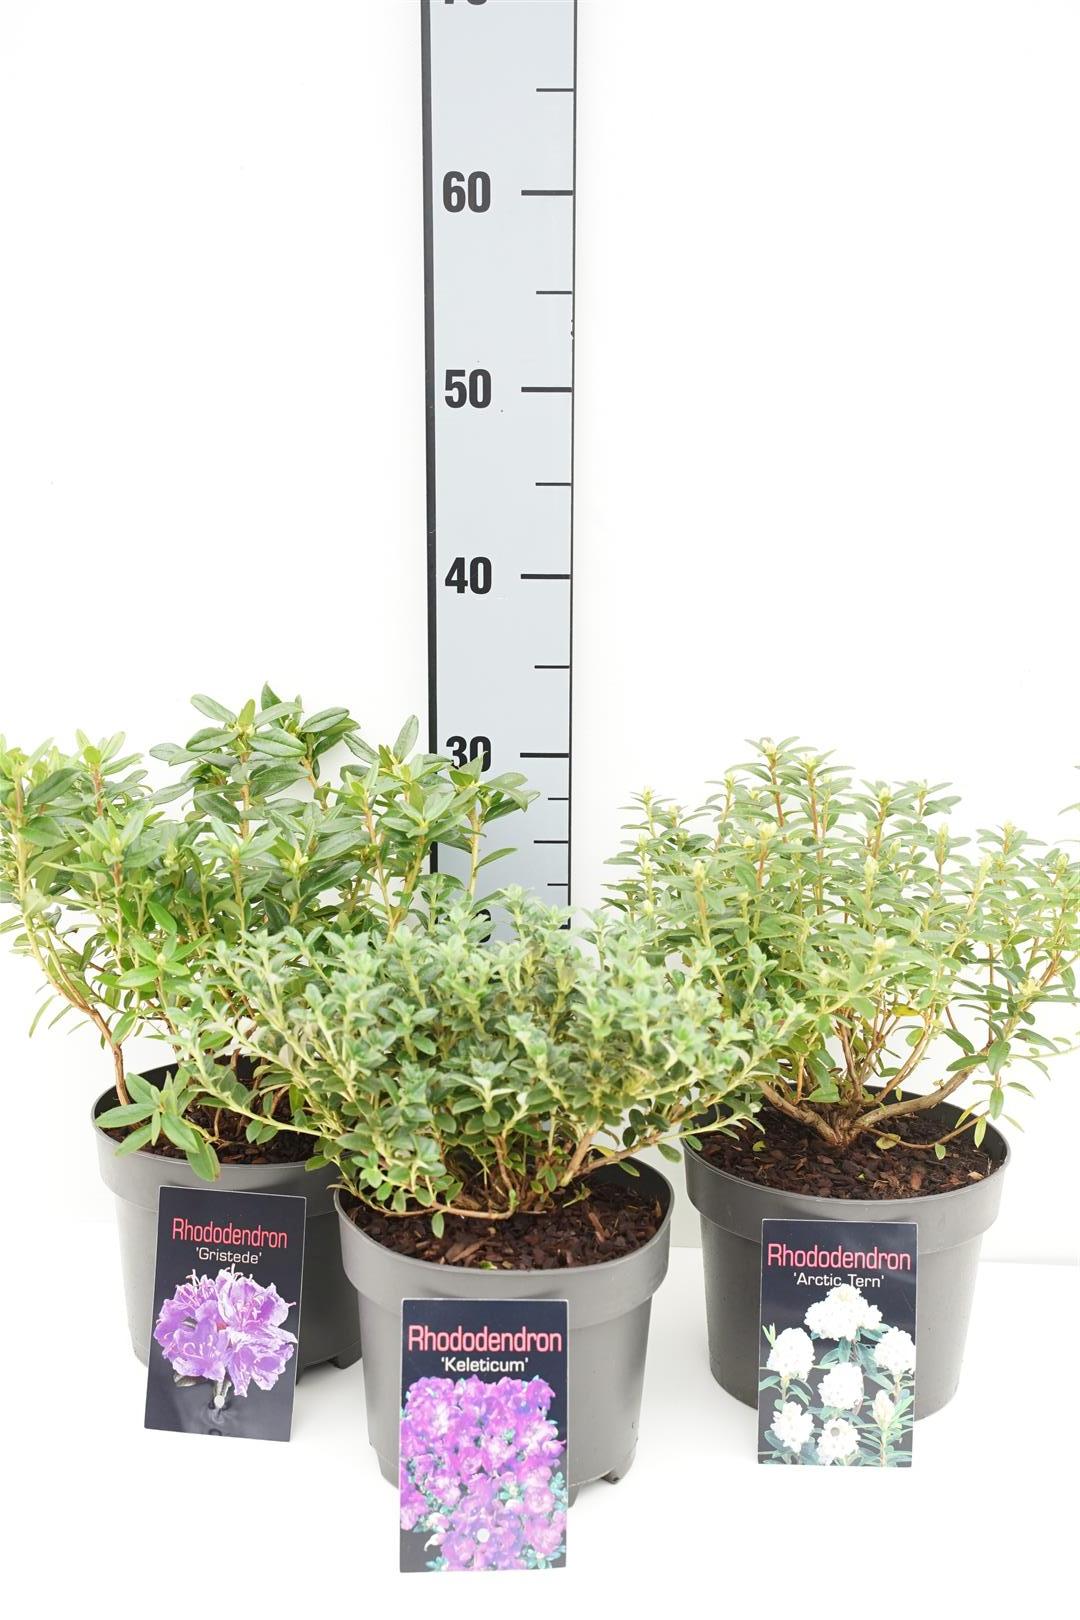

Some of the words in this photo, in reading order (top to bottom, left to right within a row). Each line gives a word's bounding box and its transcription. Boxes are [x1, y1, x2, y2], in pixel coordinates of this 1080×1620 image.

[443, 170, 491, 213] 60
[444, 368, 492, 409] 50
[444, 556, 492, 594] 40
[445, 735, 492, 773] 30
[172, 1217, 288, 1249] Rhododendron
[196, 1246, 262, 1264] 'Gristede'
[767, 1243, 911, 1270] Rhododendron
[793, 1272, 843, 1286] 'Arctic
[847, 1273, 884, 1288] Tern'
[407, 1325, 562, 1352] Rhododendron
[441, 1357, 529, 1372] 'Keleticum'
